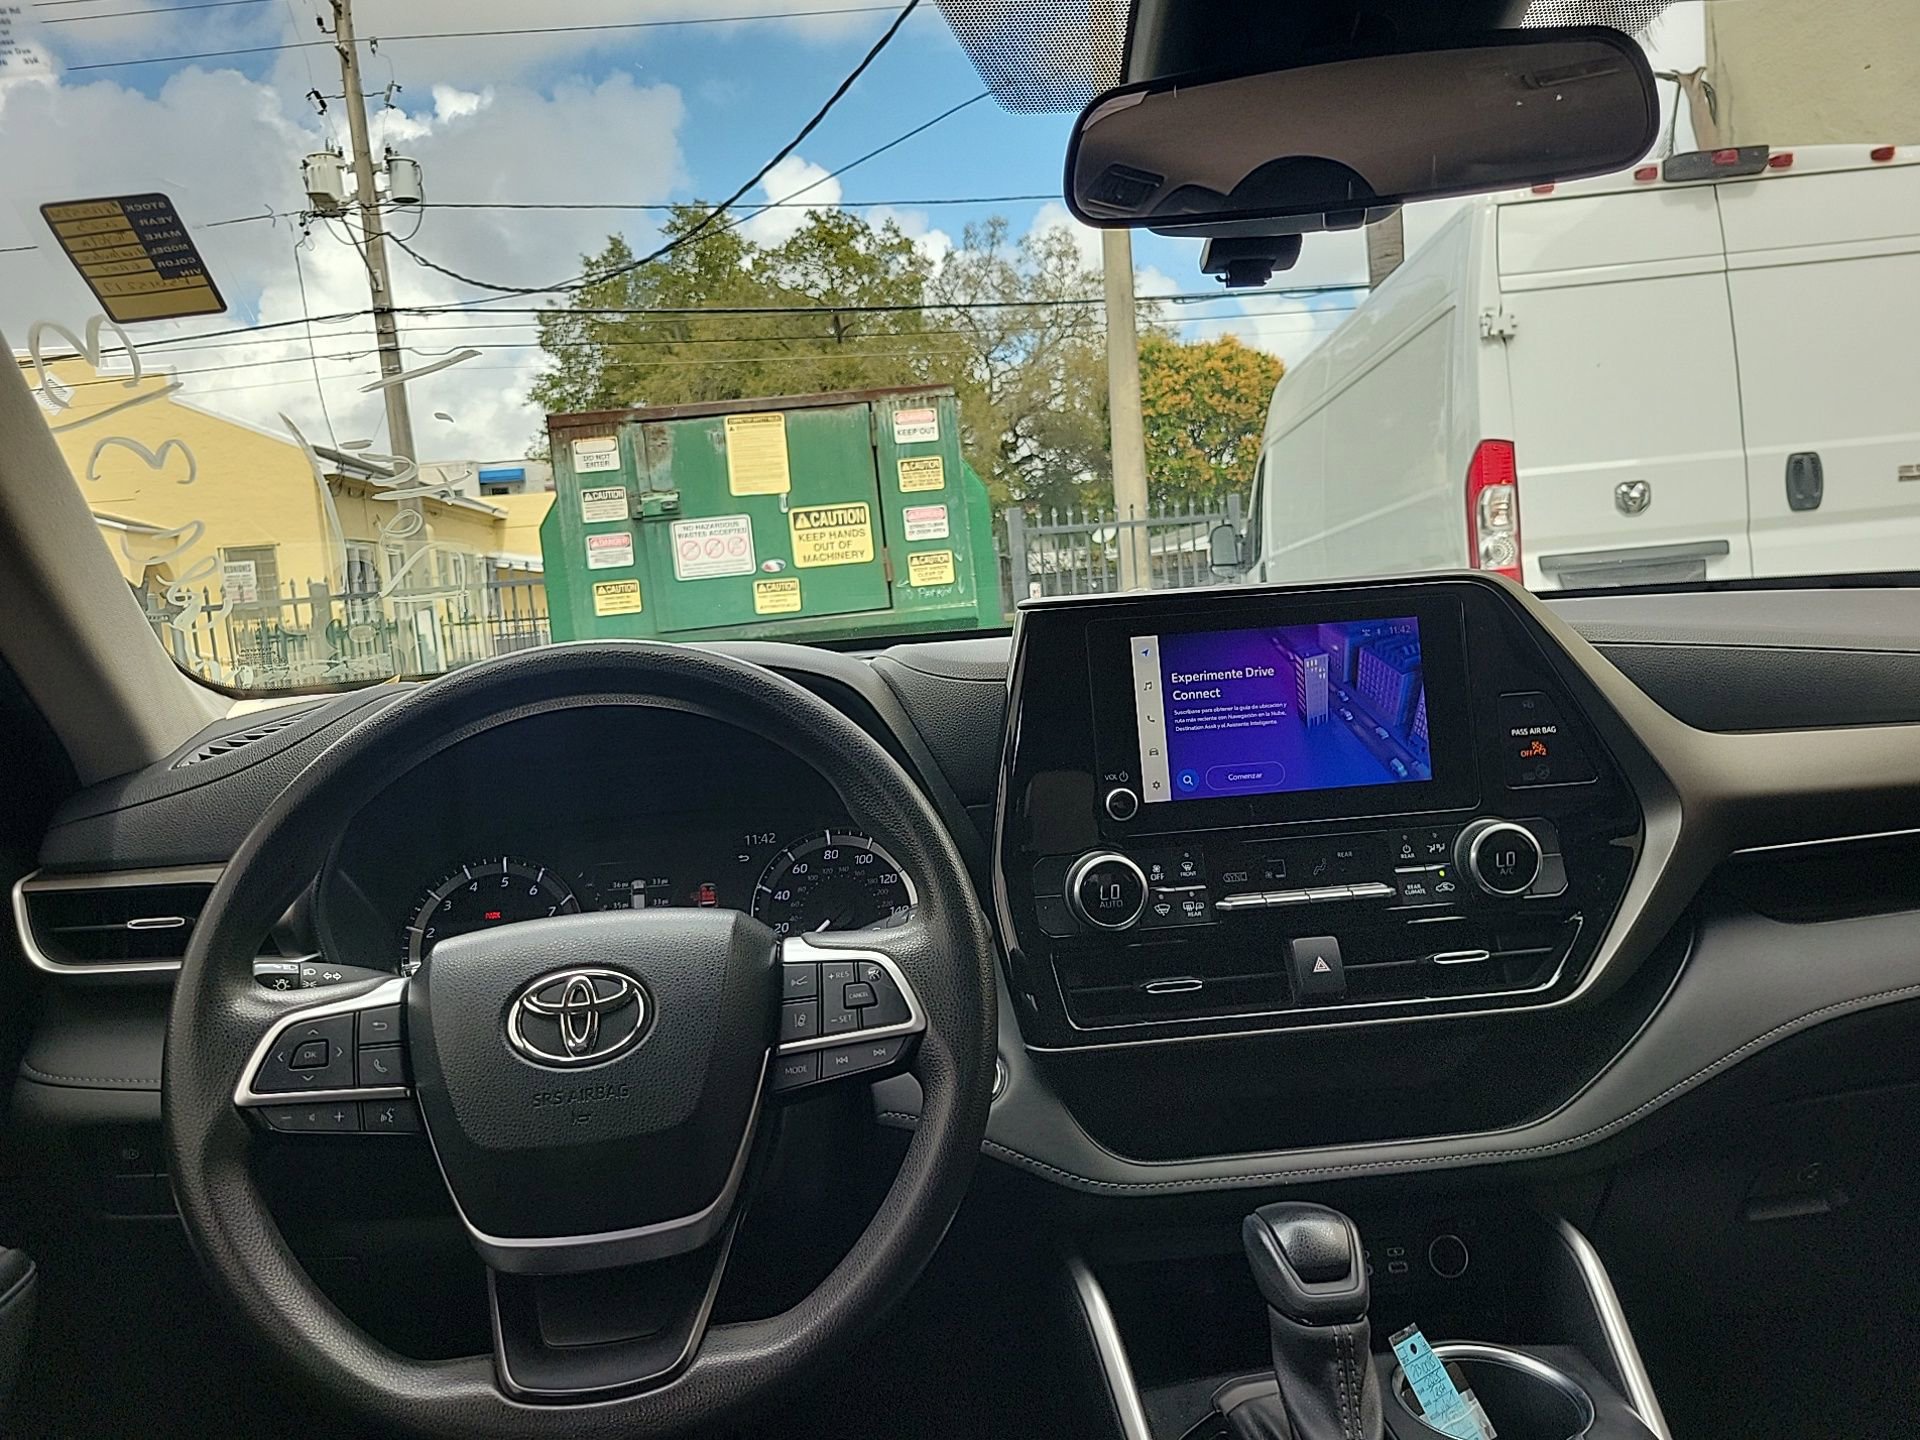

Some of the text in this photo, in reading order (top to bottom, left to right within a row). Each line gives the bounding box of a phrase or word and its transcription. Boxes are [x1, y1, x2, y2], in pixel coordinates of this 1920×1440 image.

[920, 426, 935, 434] OUT
[592, 490, 624, 500] CAUTION
[809, 510, 866, 528] CAUTION
[695, 521, 739, 530] HAZARDOUS
[709, 528, 747, 536] ACCEPTED
[798, 528, 866, 542] KEEP HANDS
[814, 540, 853, 551] OUT OF
[803, 550, 866, 563] MACHINERY
[606, 583, 638, 594] CAUTION
[1389, 624, 1411, 635] 11:42
[1171, 666, 1275, 685] Experimente Drive
[1172, 688, 1222, 701] Connect
[1175, 724, 1204, 732] Destination
[1511, 725, 1557, 736] PASS AIR BAG
[1228, 771, 1264, 782] Comenzar
[745, 833, 777, 846] 11:42
[824, 850, 839, 860] 80
[854, 854, 874, 865] 100
[1496, 851, 1516, 867] LO
[792, 864, 808, 874] 60
[501, 877, 510, 887] 5
[879, 873, 898, 884] 120
[1150, 873, 1165, 881] OFF
[469, 881, 478, 892] 4
[529, 886, 538, 895] 6
[1100, 883, 1120, 900] LO
[774, 890, 791, 901] 40
[443, 900, 452, 911] 3
[1099, 900, 1123, 909] AUTO
[548, 906, 557, 917] 7
[426, 927, 436, 939] 2
[774, 922, 790, 934] 20
[533, 1083, 629, 1108] SRS AIRBAG
